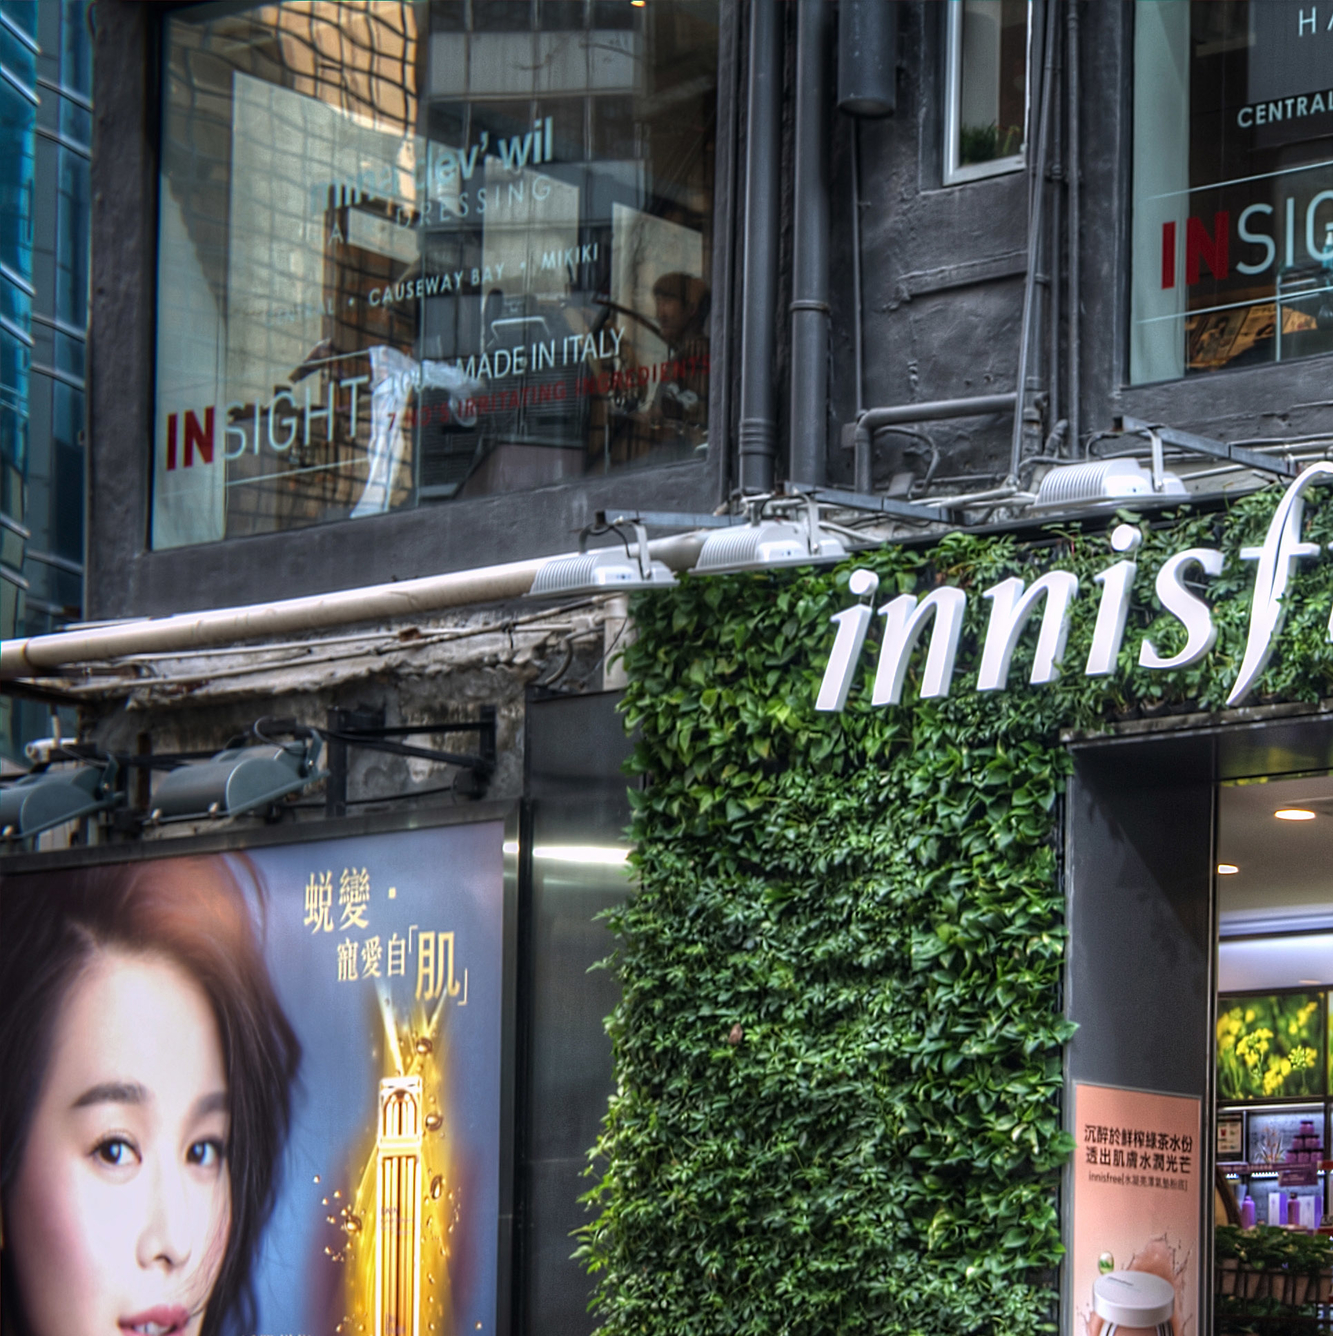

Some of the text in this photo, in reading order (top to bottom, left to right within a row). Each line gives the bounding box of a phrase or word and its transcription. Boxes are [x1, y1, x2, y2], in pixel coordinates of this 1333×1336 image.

[499, 116, 553, 170] wil
[369, 272, 463, 307] CAUSEWAY
[471, 263, 505, 285] BAY
[542, 243, 599, 270] MIKIKI
[457, 346, 525, 380] MADE
[532, 339, 555, 372] IN
[562, 327, 626, 367] ITALY
[166, 373, 369, 472] INSIGHT
